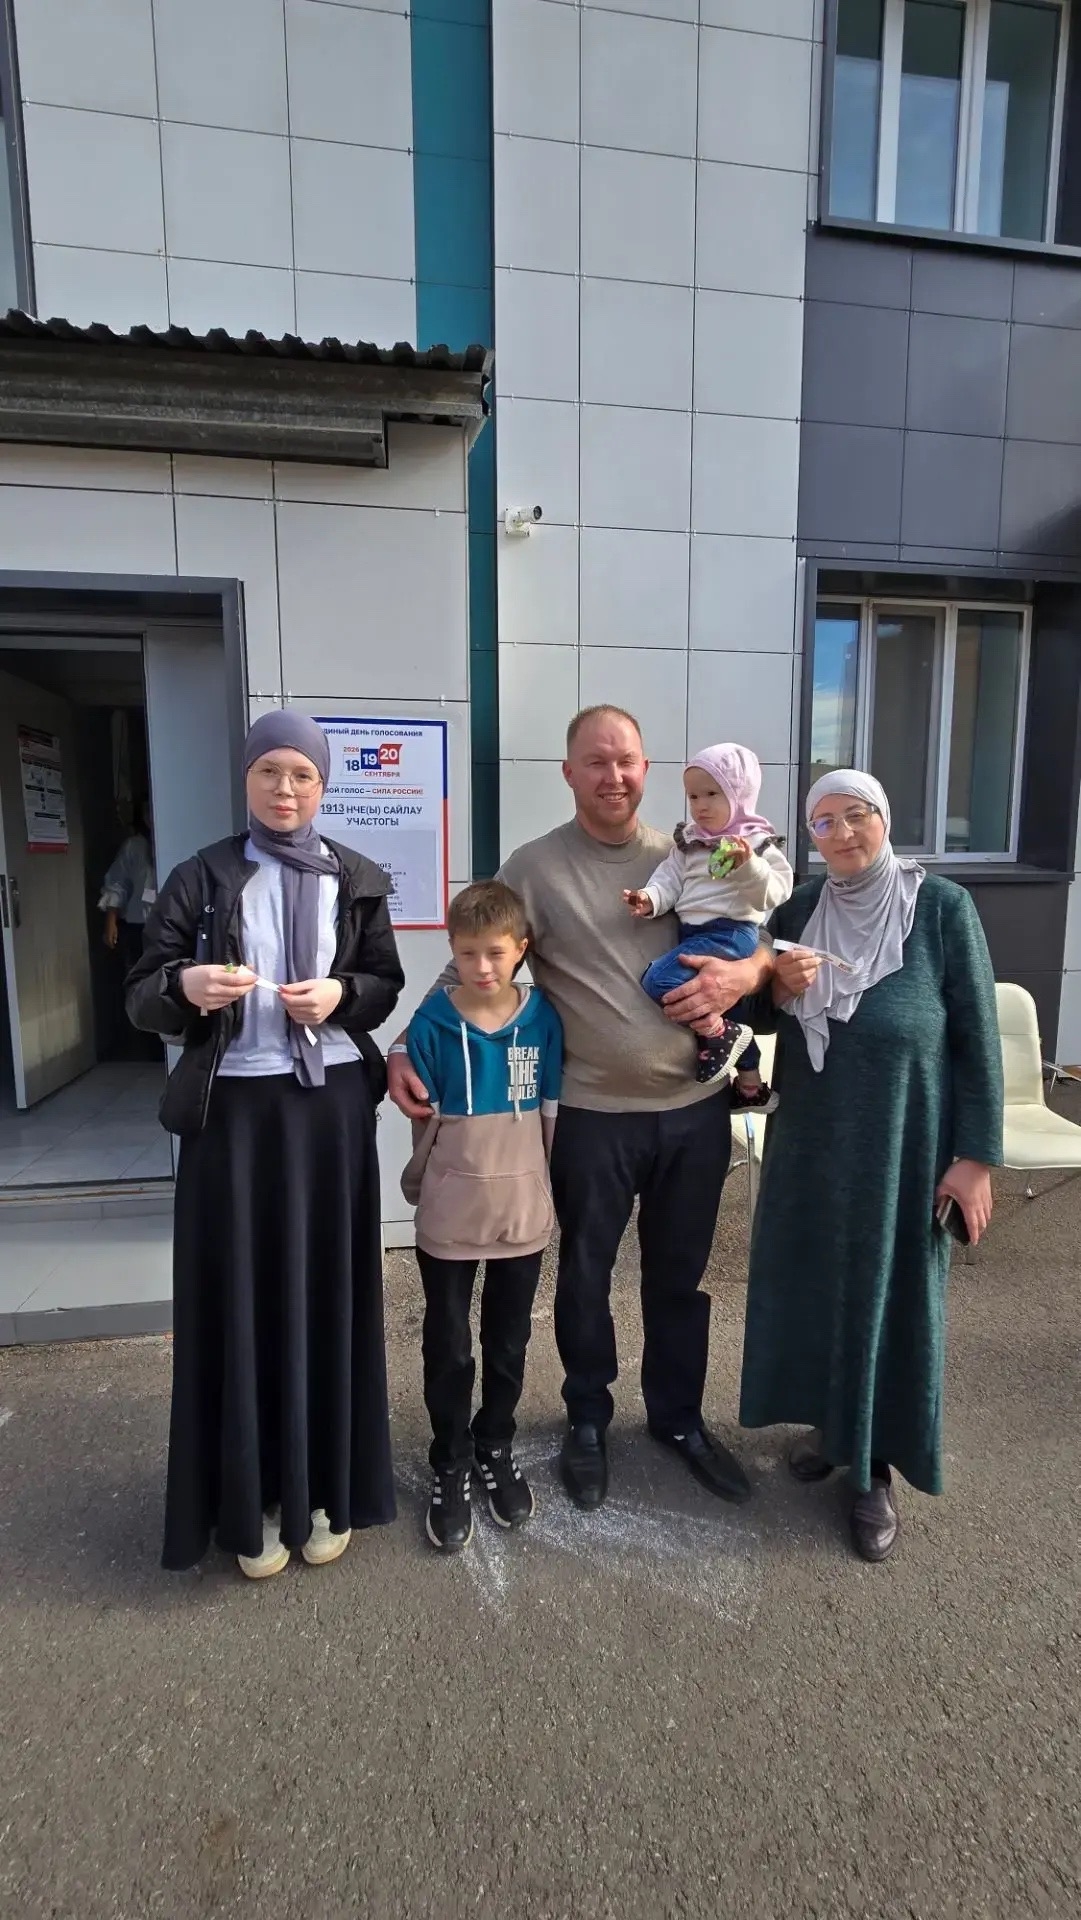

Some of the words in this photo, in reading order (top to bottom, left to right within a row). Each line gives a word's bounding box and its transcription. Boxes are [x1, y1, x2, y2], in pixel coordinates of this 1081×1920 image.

[322, 727, 349, 735] ДИНЫЙ
[345, 759, 360, 771] 18
[362, 753, 378, 766] 19
[379, 747, 398, 760] 20
[325, 786, 340, 794] ВОЙ
[320, 803, 345, 813] 1913
[346, 805, 381, 816] НЧЕ(Ы)
[383, 805, 423, 815] САЙЛАУ
[345, 817, 400, 826] УЧАСТОГЫ
[507, 1046, 540, 1060] BREAK
[507, 1060, 539, 1086] THE
